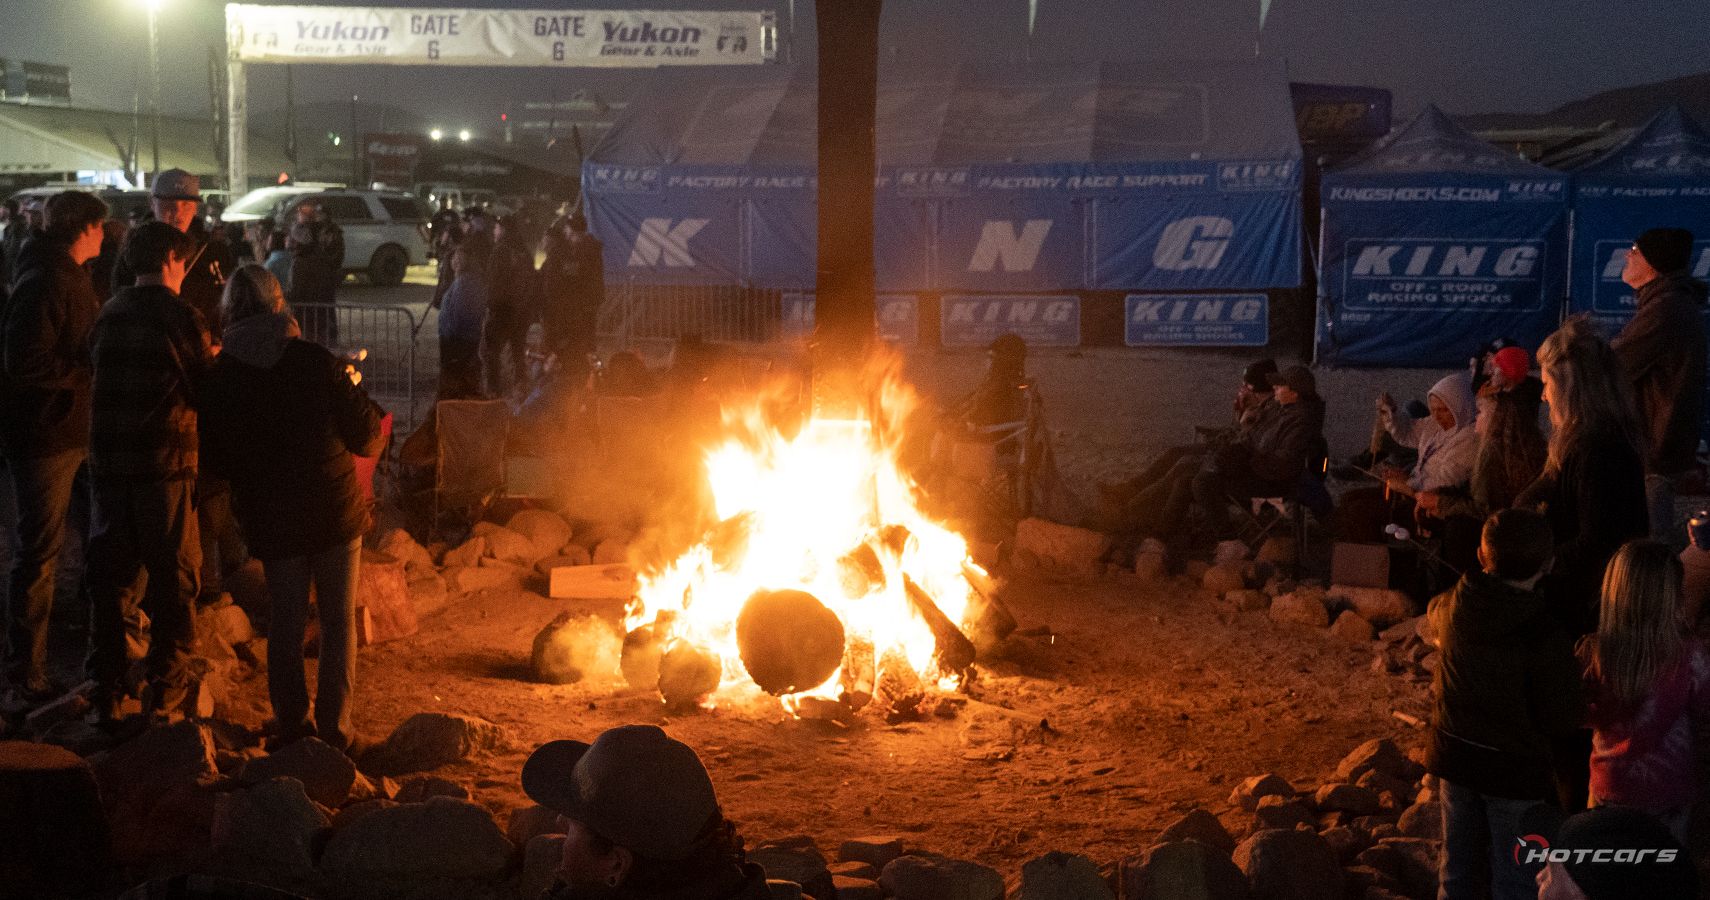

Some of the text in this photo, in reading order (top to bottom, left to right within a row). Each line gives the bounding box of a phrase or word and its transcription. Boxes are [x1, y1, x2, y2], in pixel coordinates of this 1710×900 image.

[296, 21, 390, 42] Yukon
[410, 14, 460, 36] GATE
[534, 16, 585, 38] GATE
[602, 21, 702, 44] Yukon
[427, 40, 440, 60] 6
[552, 41, 565, 61] 6
[600, 44, 701, 57] Gear & Axle
[900, 172, 967, 184] KING
[1220, 164, 1292, 179] KING
[667, 176, 751, 188] FACTORY
[754, 176, 804, 188] RACE
[1065, 176, 1118, 189] RACE
[1123, 174, 1210, 188] SUPPORT
[1507, 181, 1562, 193] KING
[1329, 186, 1501, 201] KINGSHOCKS.COM
[1612, 187, 1677, 196] FACTORY
[1352, 245, 1539, 276] KING
[1367, 293, 1513, 304] RACING SHOCKS
[947, 301, 1074, 323] KING
[1132, 299, 1263, 322] KING
